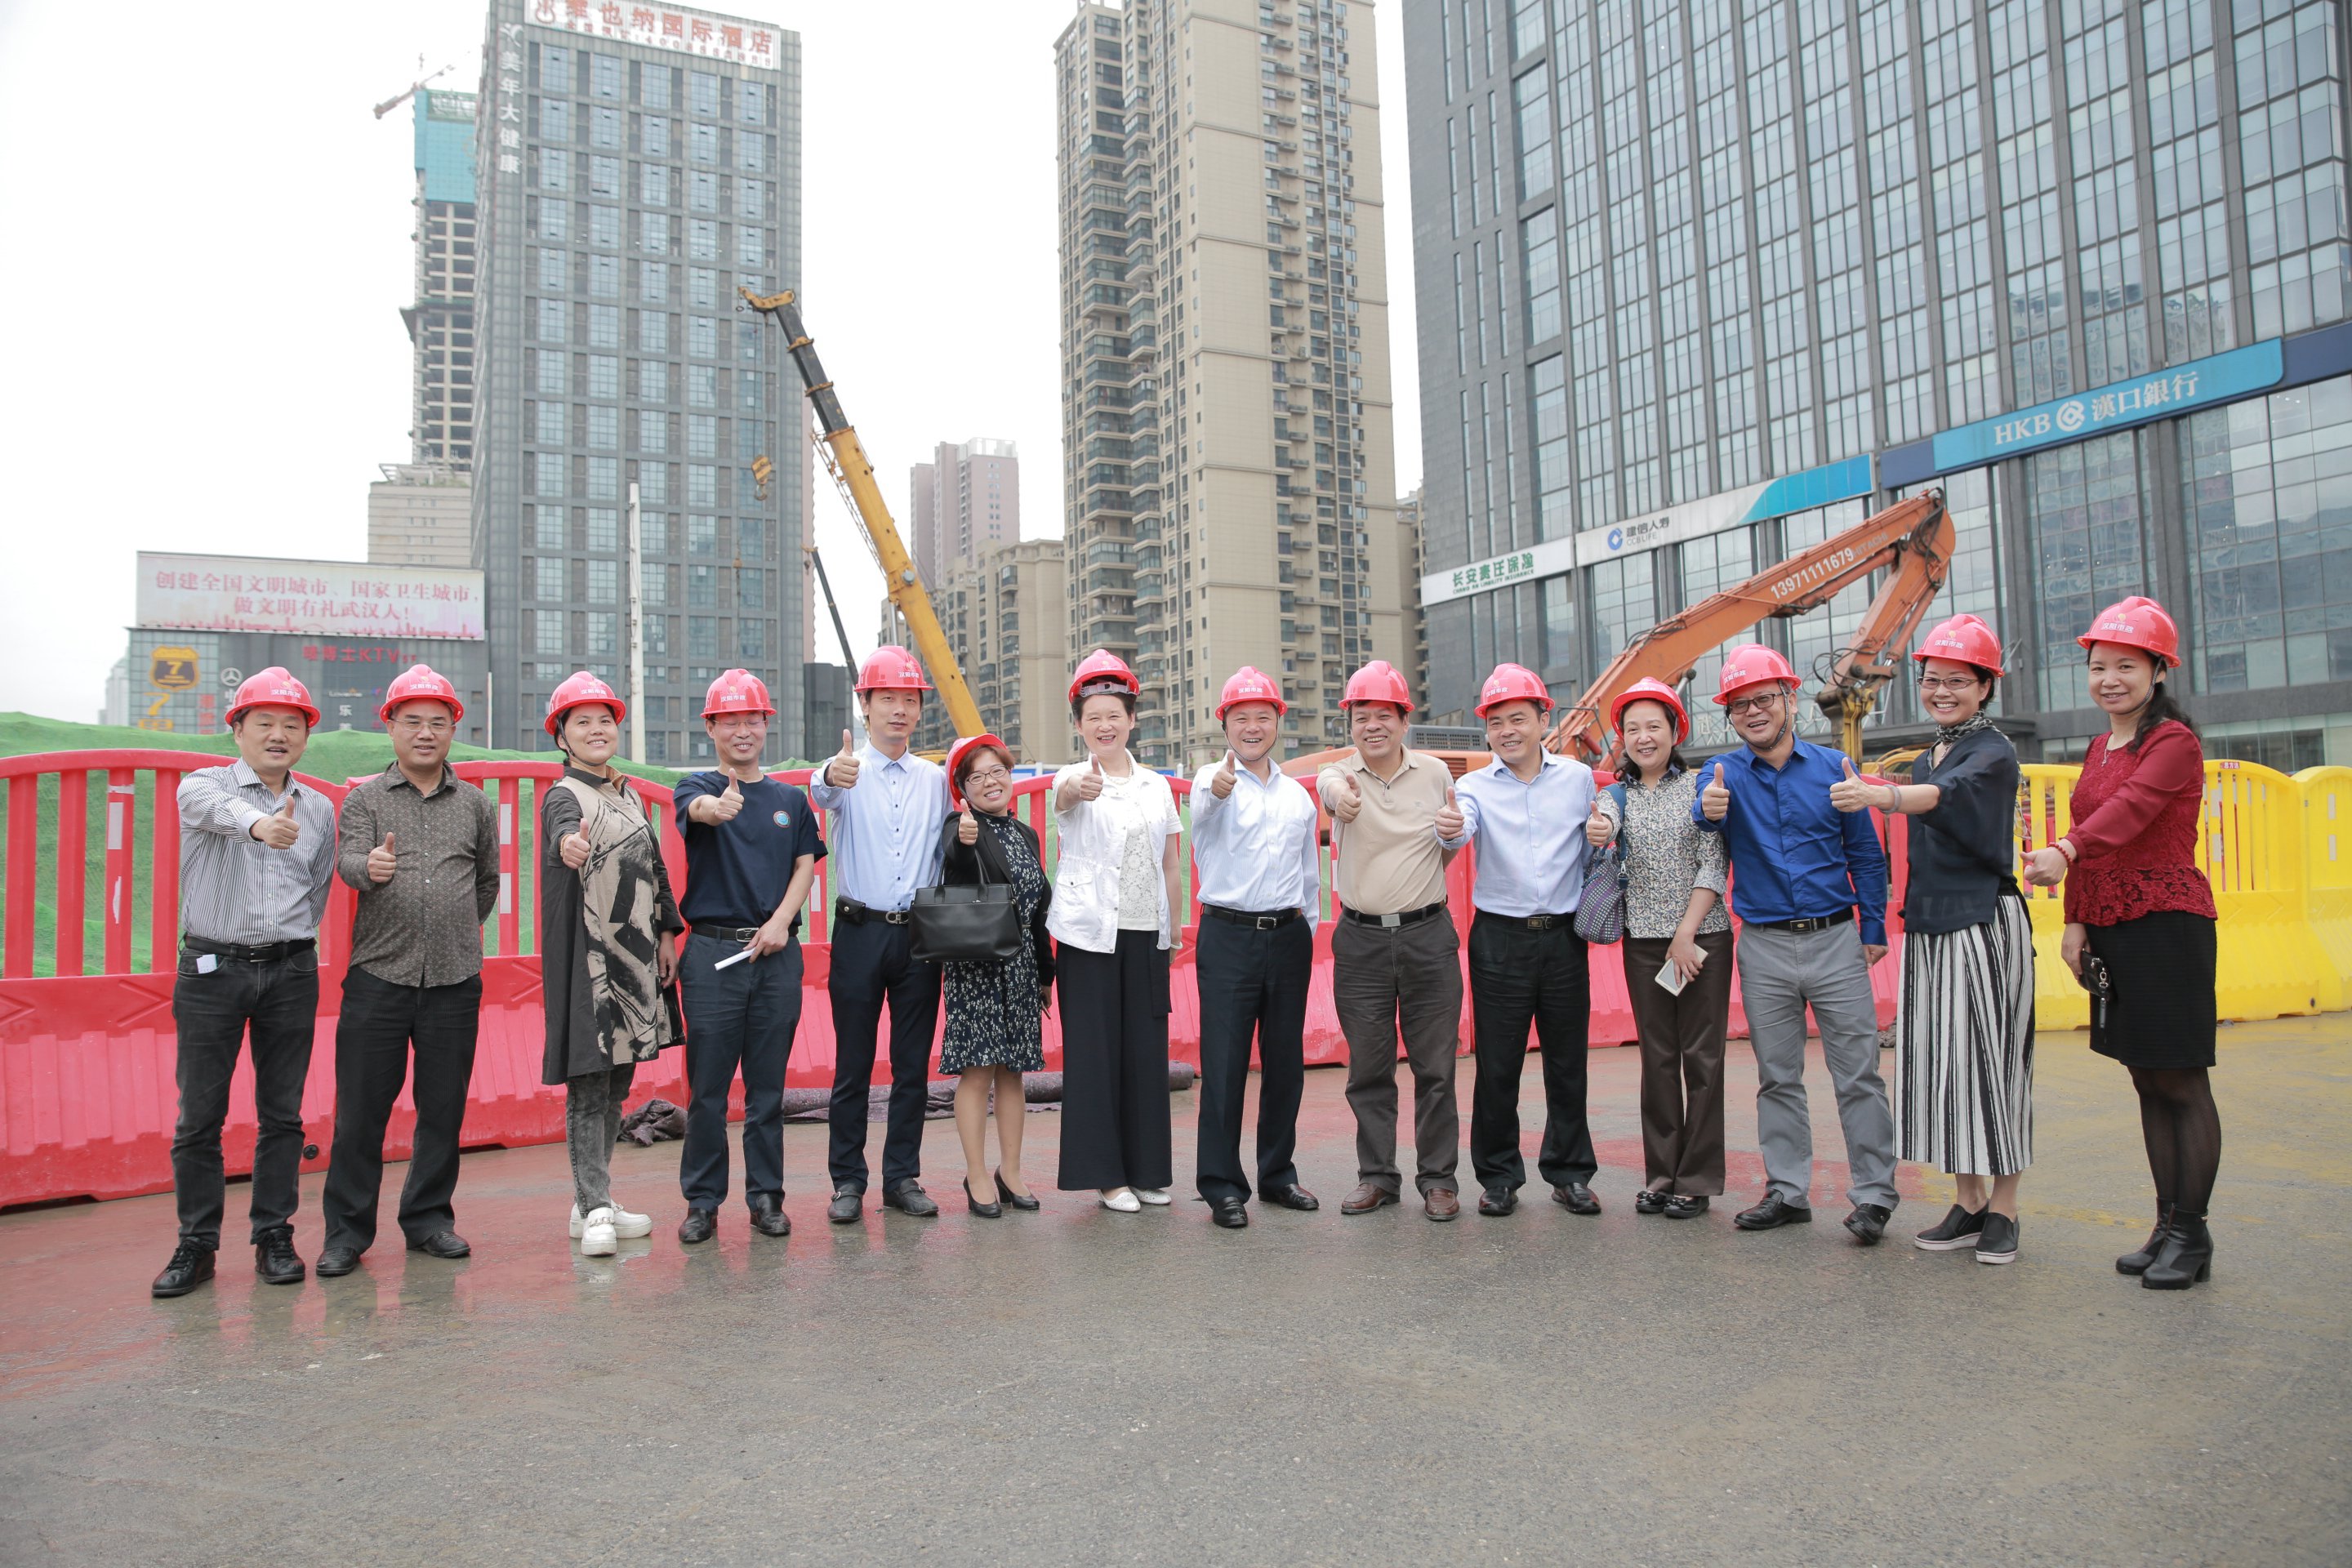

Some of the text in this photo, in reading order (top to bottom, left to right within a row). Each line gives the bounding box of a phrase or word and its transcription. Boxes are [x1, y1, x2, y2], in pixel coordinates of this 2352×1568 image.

[565, 0, 772, 55] 维也纳国际酒店
[499, 51, 523, 174] 美年大健康
[1994, 371, 2199, 446] HKB 漢口銀行
[1626, 516, 1670, 537] 建信人寿
[1453, 552, 1534, 587] 长安责任保险
[1771, 547, 1855, 599] 13971111679
[1935, 639, 1964, 649] 汉阳市政
[2101, 622, 2134, 634] 汉阳市政
